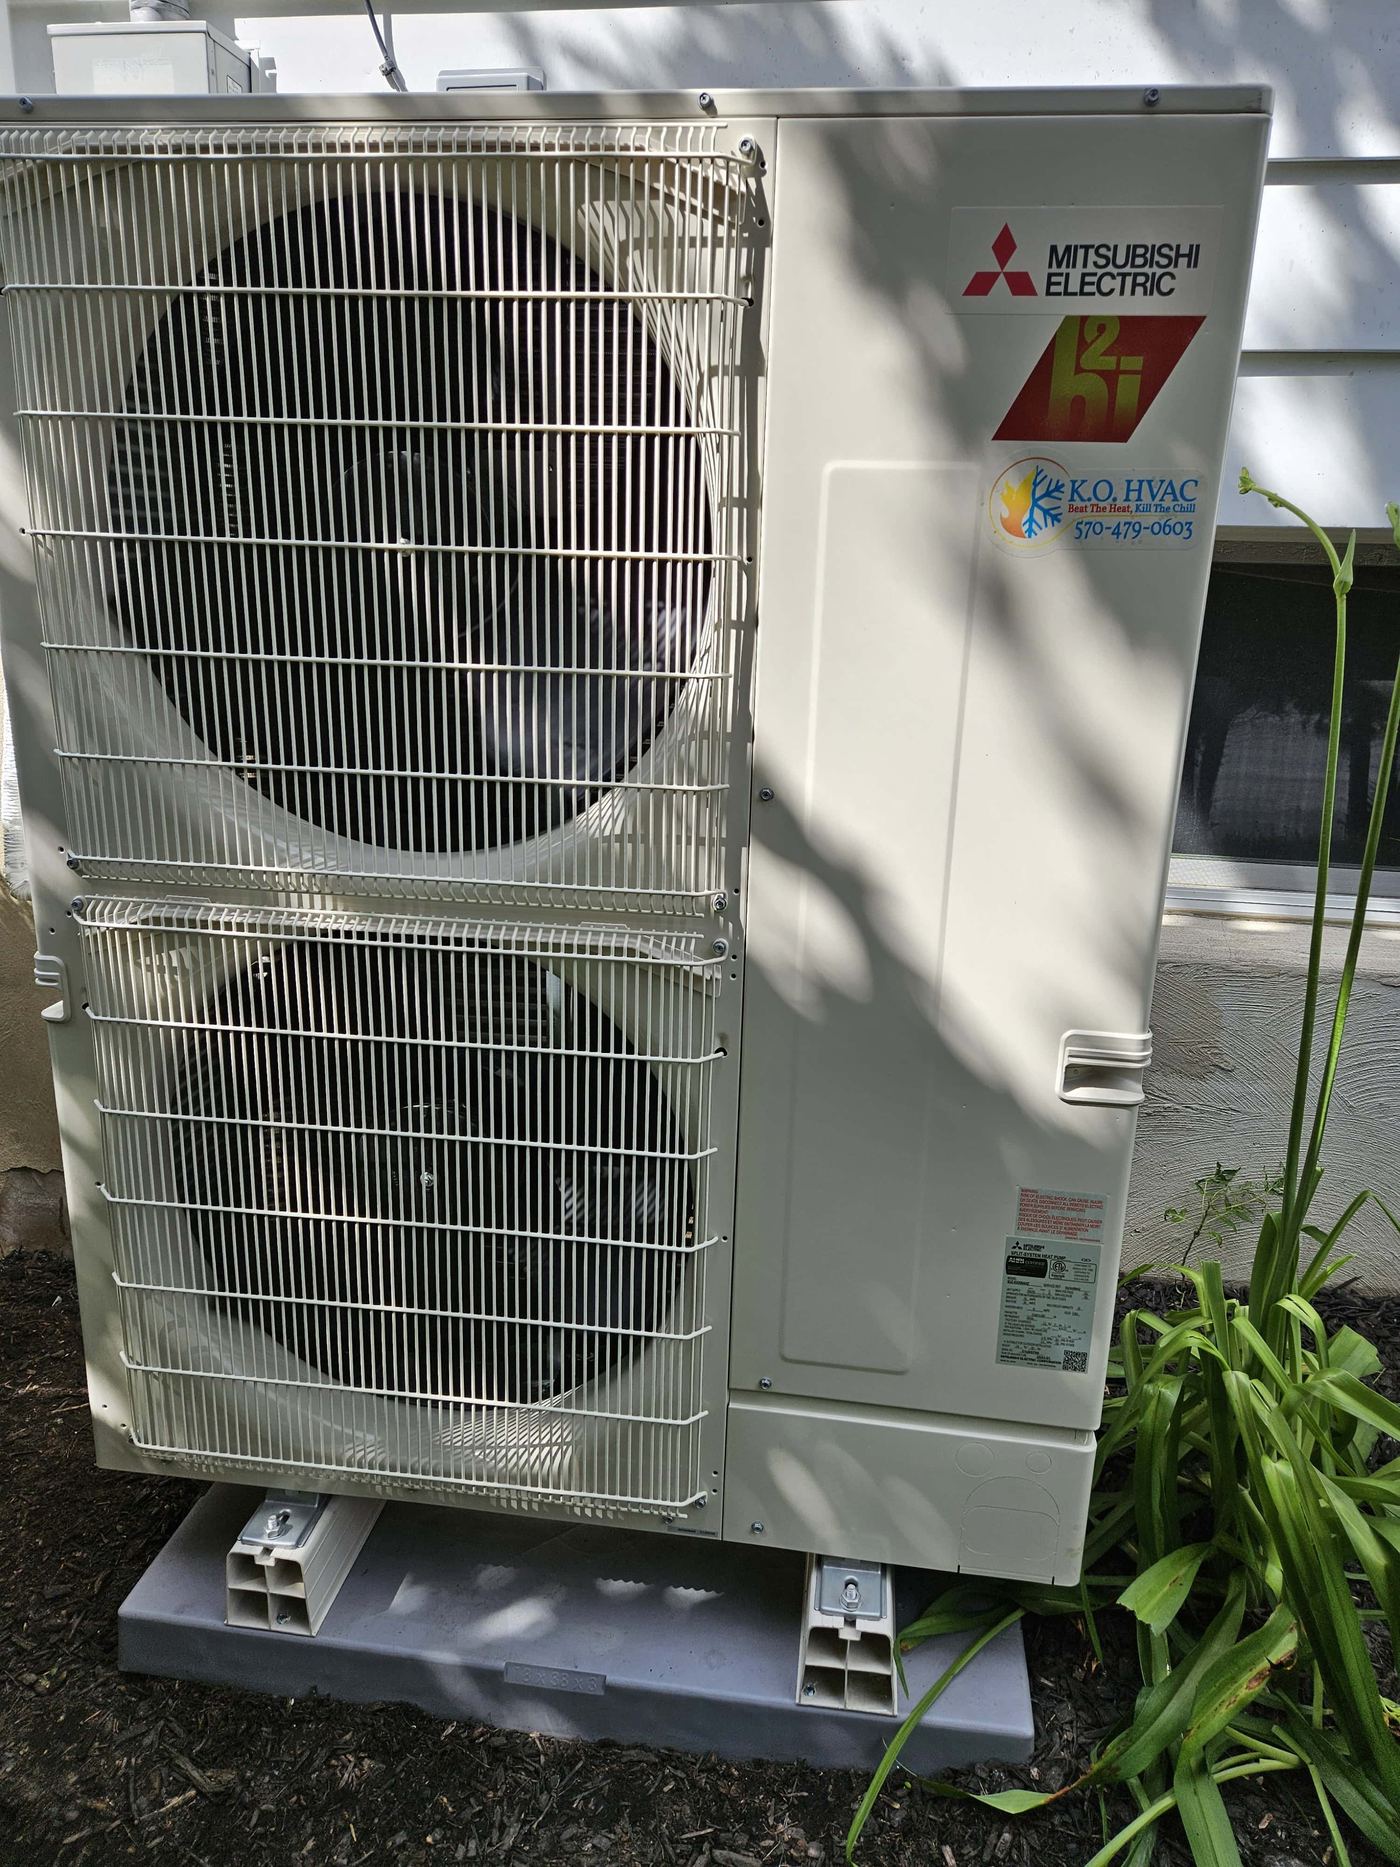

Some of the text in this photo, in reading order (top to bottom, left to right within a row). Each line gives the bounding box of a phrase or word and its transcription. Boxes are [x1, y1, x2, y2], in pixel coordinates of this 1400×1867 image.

[1047, 243, 1200, 270] MITSUBISHI
[1045, 271, 1176, 297] ELECTRIC
[1068, 479, 1199, 502] K.O. HVAC
[1068, 504, 1196, 514] Beat The Heat, Kill The Chill
[1074, 519, 1193, 540] 570-479-0603
